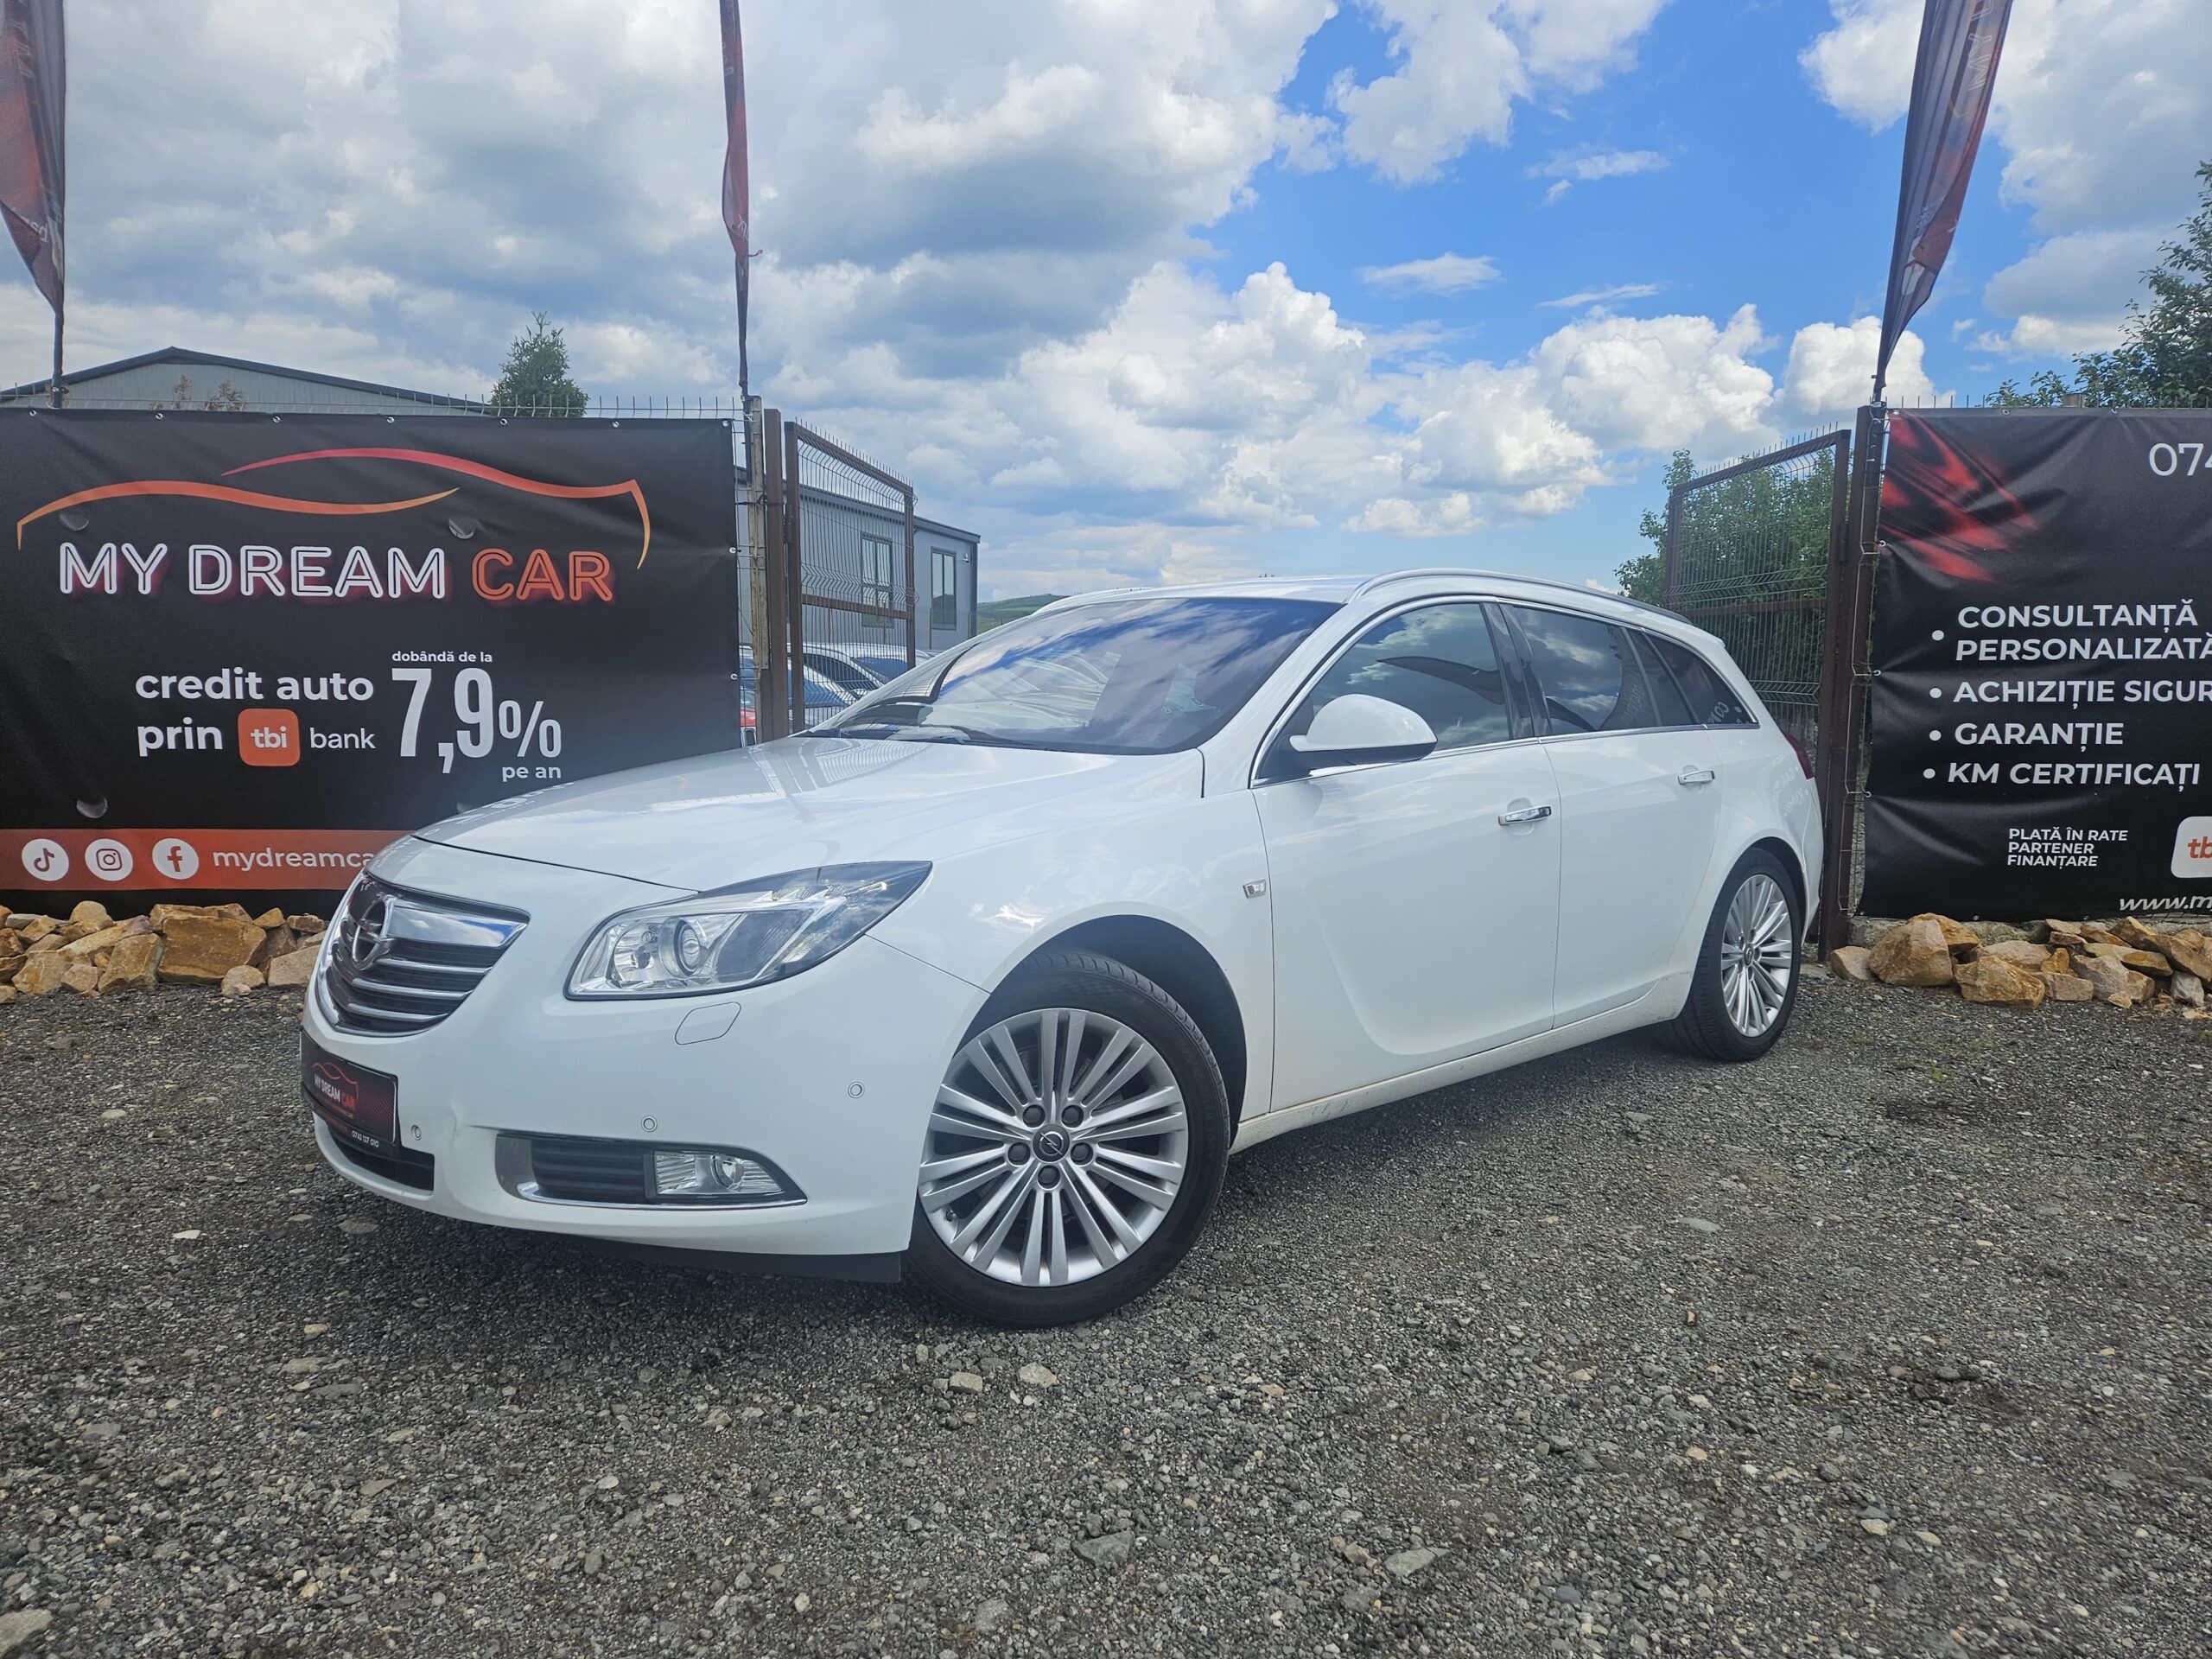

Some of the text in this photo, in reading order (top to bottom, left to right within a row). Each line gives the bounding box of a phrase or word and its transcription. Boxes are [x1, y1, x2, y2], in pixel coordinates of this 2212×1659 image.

[59, 542, 613, 601] MY DREAM CAR
[1957, 598, 2199, 633] CONSULTANȚĂ
[391, 650, 493, 664] dobândă de la
[135, 666, 374, 701] credit auto
[1953, 680, 2115, 710] ACHIZIȚIE
[137, 716, 377, 757] prin tbi bank
[1955, 722, 2124, 753] GARANȚIE
[501, 765, 563, 782] pe an
[1948, 762, 2201, 792] KM CERTIFICAȚI
[2008, 842, 2094, 855] PARTENER
[2009, 826, 2129, 842] PLATĂ ÎN RATE
[2120, 895, 2212, 912] www.m
[321, 1078, 340, 1103] DREAM
